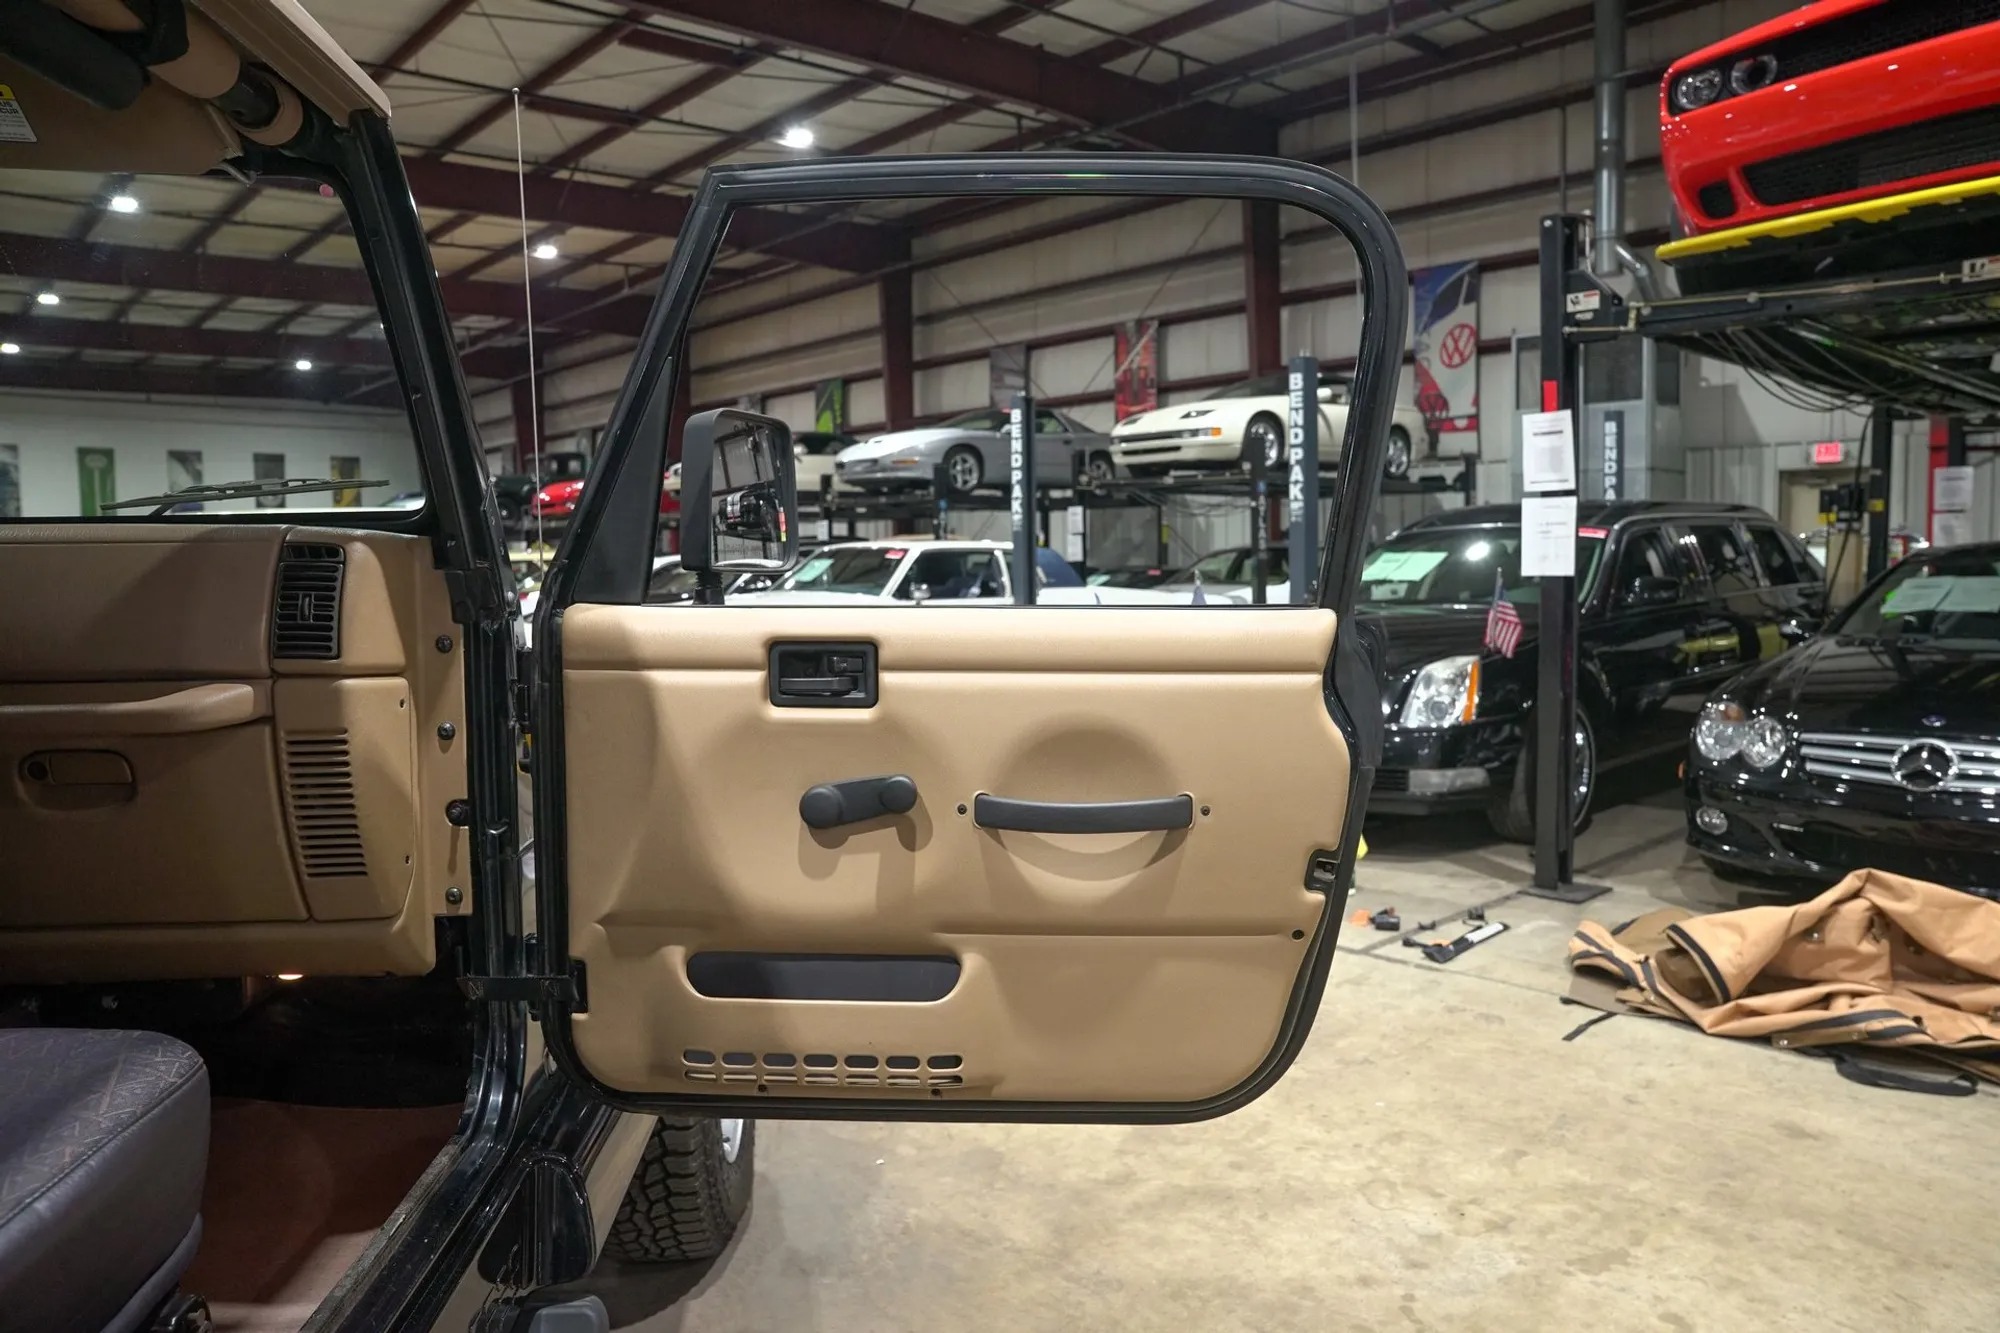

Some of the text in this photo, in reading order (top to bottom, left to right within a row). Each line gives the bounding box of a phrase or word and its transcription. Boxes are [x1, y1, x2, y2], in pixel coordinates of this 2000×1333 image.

[1010, 408, 1023, 513] BENDPAK
[1289, 373, 1304, 500] BENDPAK
[1604, 421, 1617, 501] BENDPA
